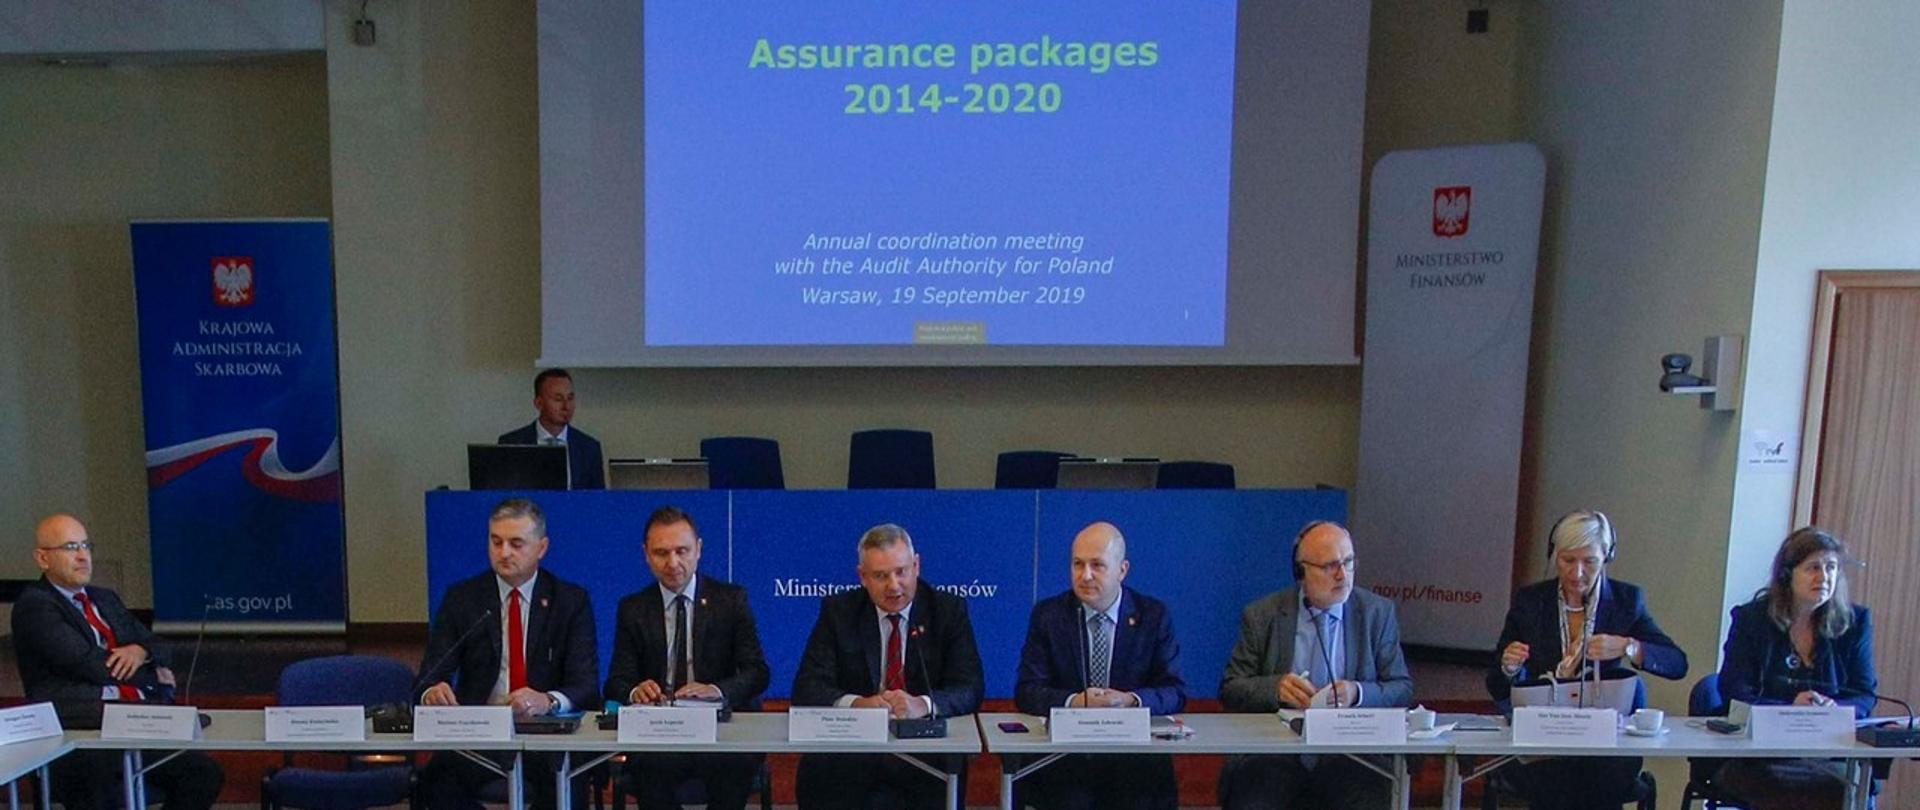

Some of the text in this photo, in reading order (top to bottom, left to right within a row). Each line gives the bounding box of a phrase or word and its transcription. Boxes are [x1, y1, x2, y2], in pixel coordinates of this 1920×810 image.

[749, 35, 1159, 74] Assurance packages
[843, 82, 1063, 114] 2014-2020
[803, 232, 1085, 254] Annual coordination meeting
[774, 256, 1115, 278] with the Audit Authority for Poland
[1395, 251, 1504, 268] MINISTERSTWO
[802, 286, 1086, 308] Warsaw, 19 September 2019
[199, 319, 275, 337] KRAJOWA
[172, 341, 303, 358] ADMINISTRACJA
[194, 361, 283, 376] SKARBOWA
[204, 593, 294, 614] as.gov.pl
